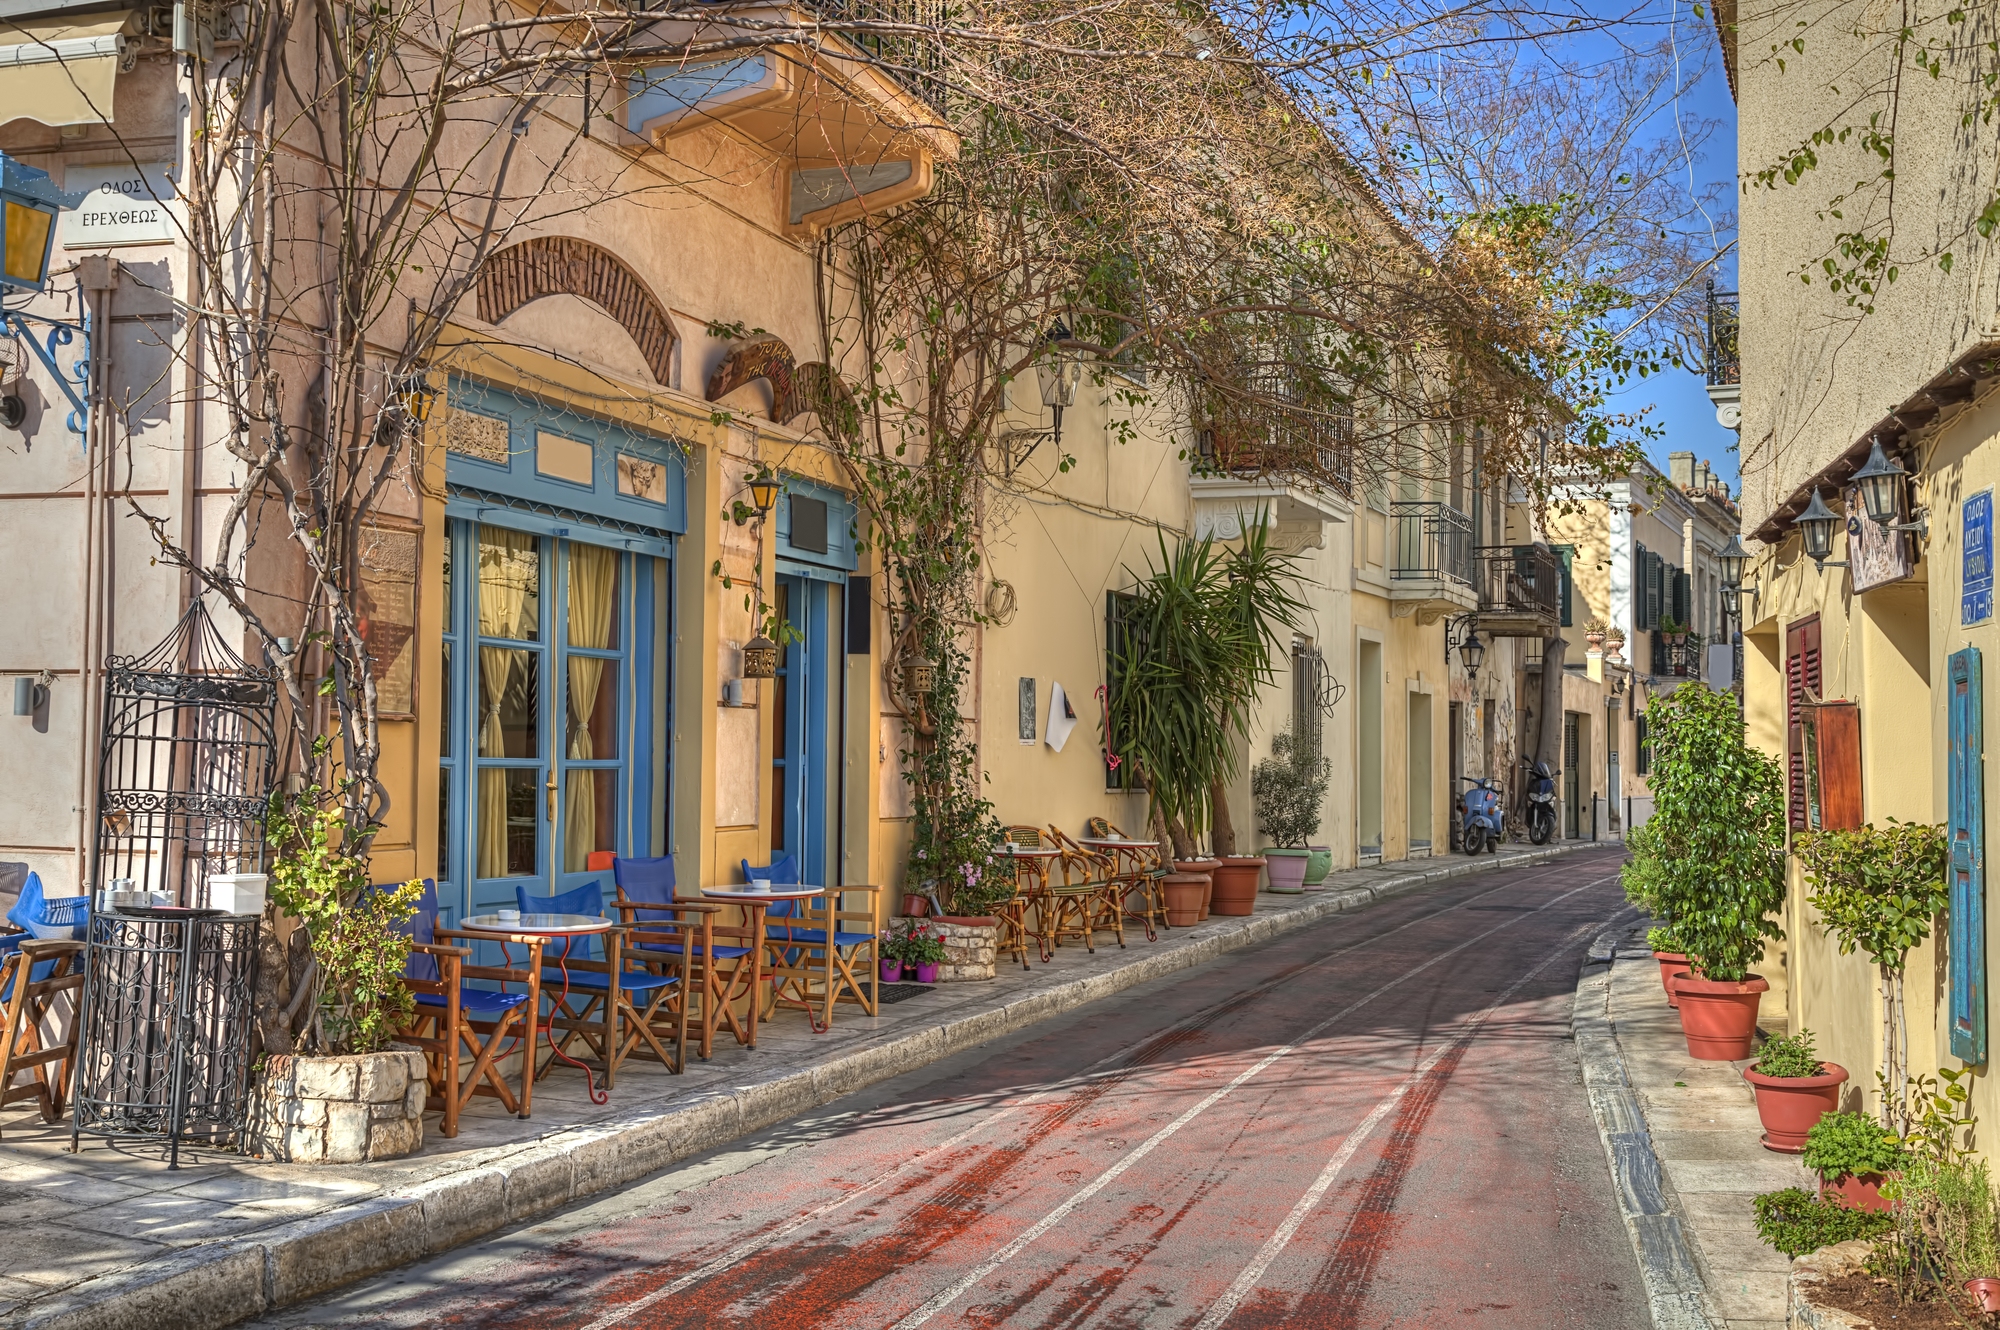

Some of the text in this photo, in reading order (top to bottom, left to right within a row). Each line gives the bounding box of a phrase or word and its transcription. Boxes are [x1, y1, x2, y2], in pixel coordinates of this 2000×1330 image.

[101, 180, 141, 194] ΟΔΟΣ
[82, 210, 158, 226] ΕΡΕΧΘΕΩΣ
[1966, 499, 1984, 522] ΟΔΟΣ
[1965, 524, 1984, 549] ΛΥΣΙΟΥ
[1966, 554, 1985, 578] LYSIOU
